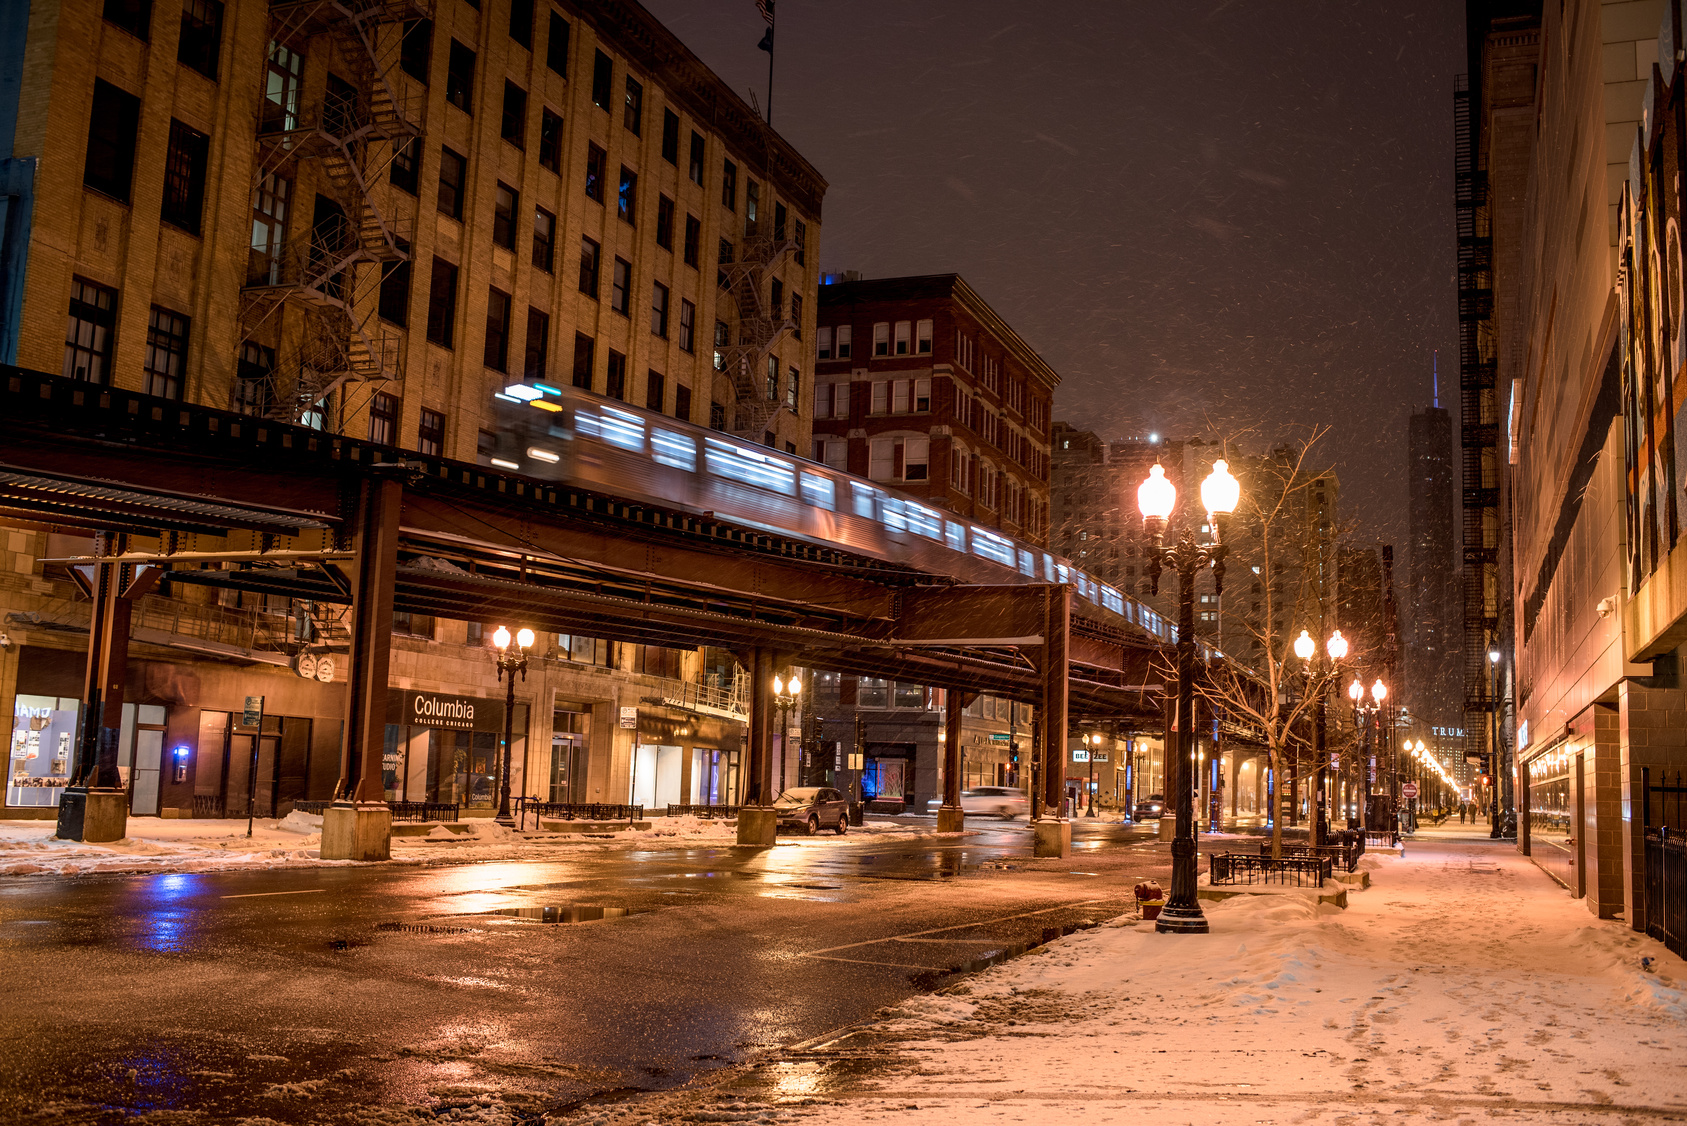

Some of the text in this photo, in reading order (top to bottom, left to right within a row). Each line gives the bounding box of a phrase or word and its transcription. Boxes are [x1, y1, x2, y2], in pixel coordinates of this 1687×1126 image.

[414, 695, 474, 719] Columbia
[414, 717, 474, 728] COLLEGE CHICAGO
[1431, 726, 1469, 737] TRUM
[471, 793, 492, 801] Columbia
